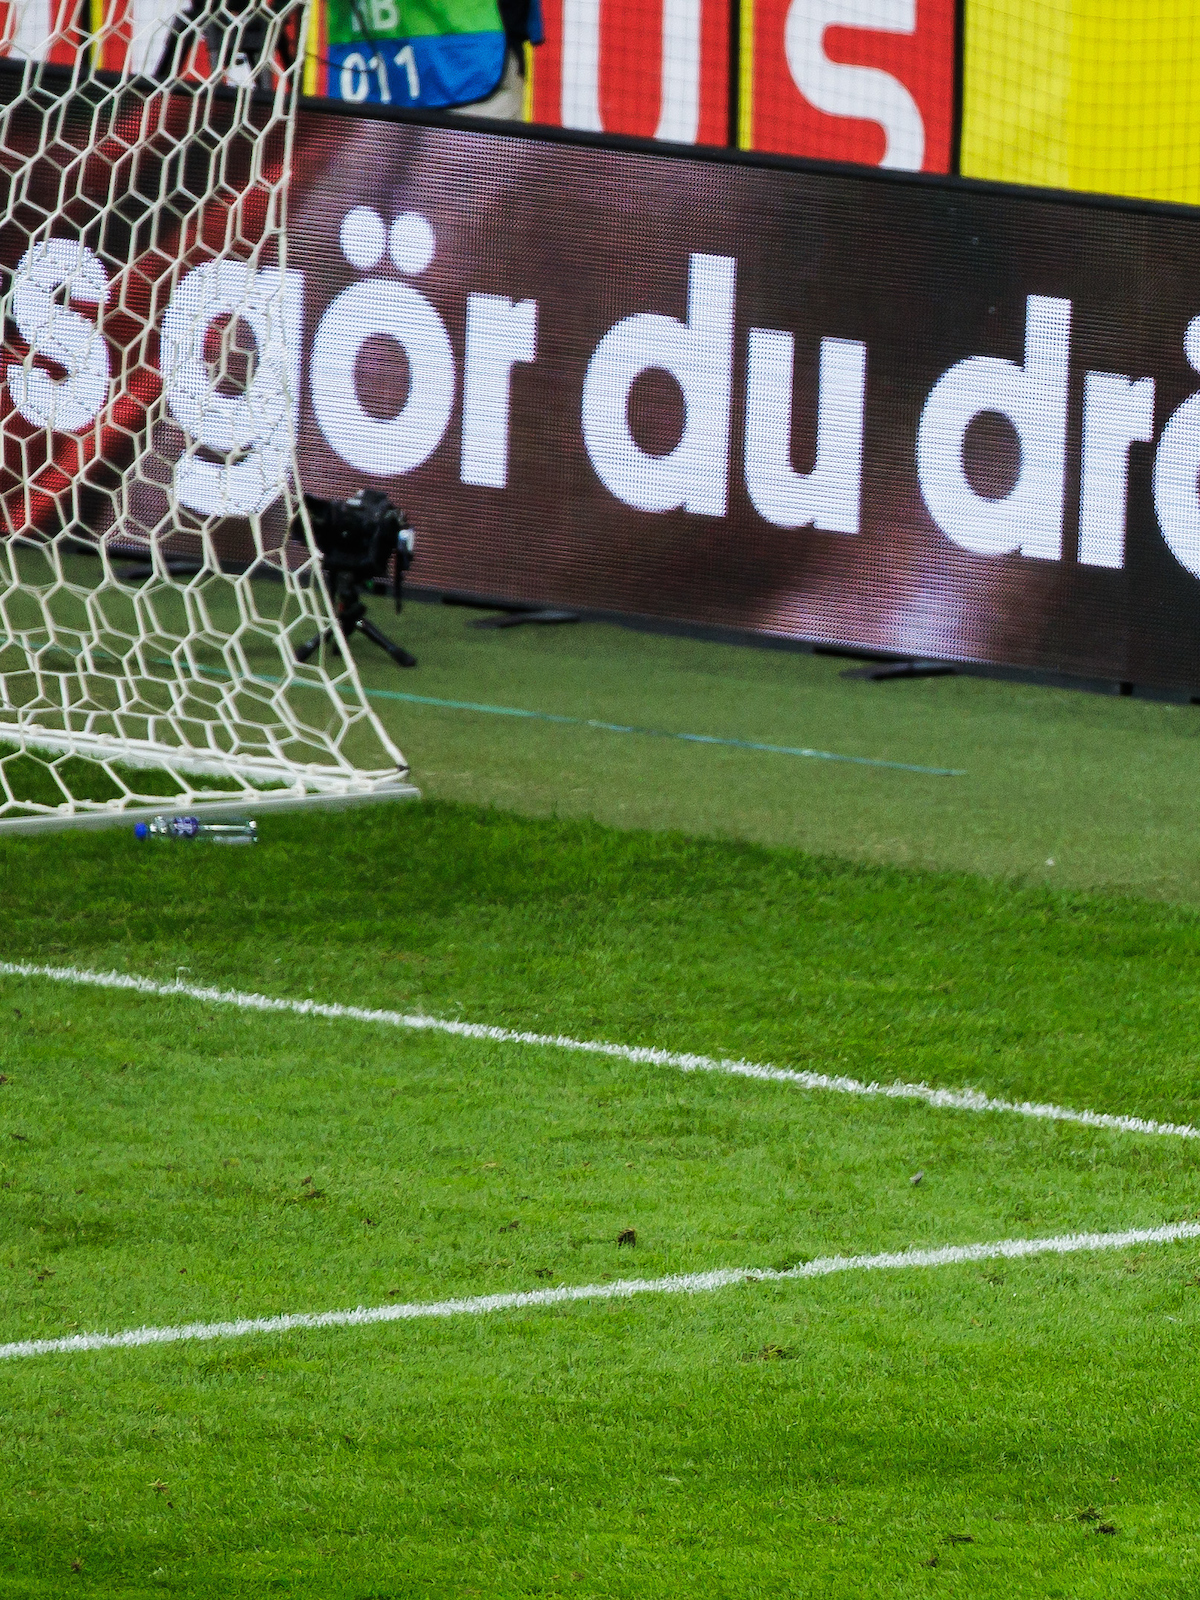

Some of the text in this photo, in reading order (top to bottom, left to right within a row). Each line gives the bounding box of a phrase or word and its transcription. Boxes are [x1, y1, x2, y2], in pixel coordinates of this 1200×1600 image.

[340, 45, 420, 104] 011
[160, 206, 538, 516] gör
[582, 253, 867, 534] du
